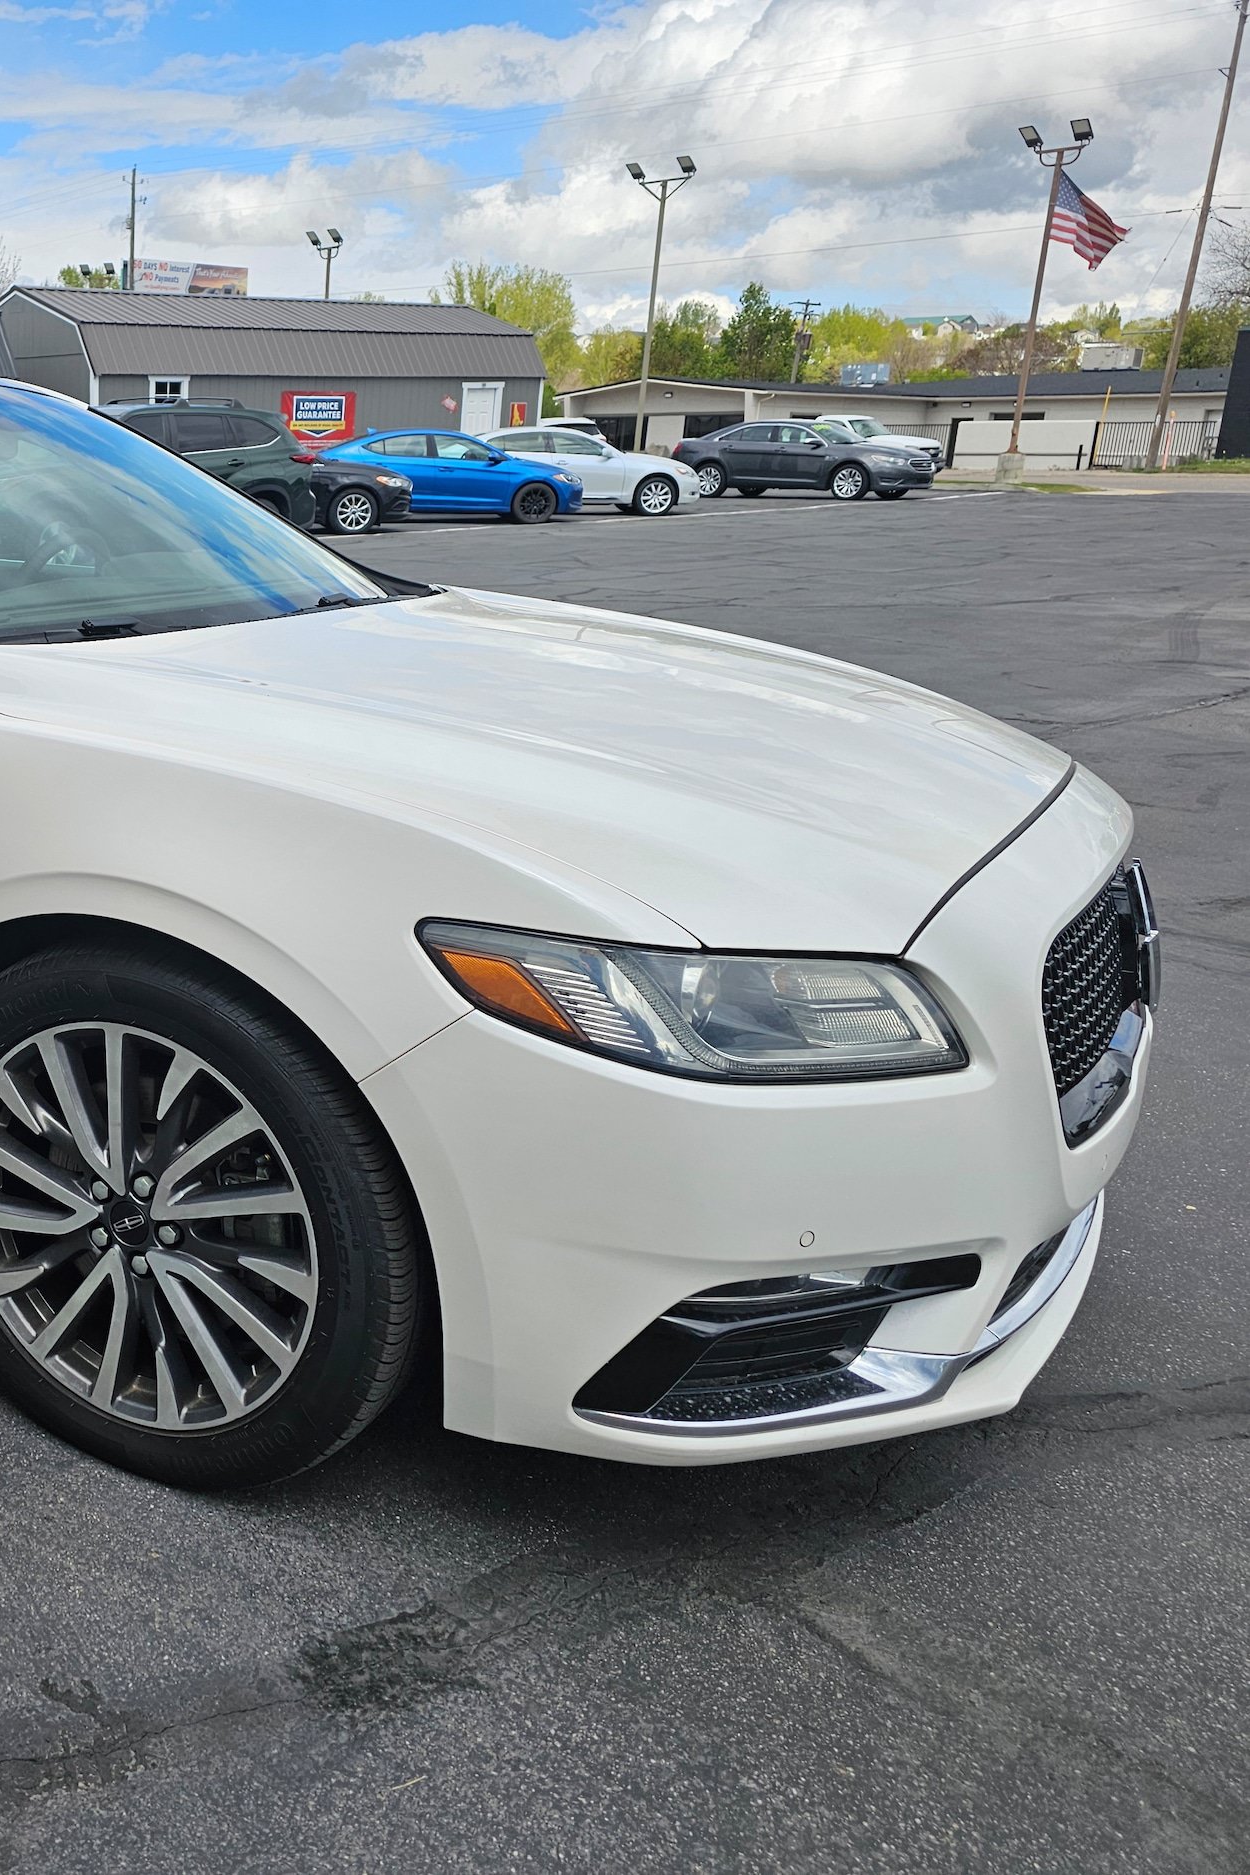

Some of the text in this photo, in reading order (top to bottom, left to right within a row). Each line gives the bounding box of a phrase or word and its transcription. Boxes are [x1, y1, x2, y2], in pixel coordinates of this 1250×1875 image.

[143, 261, 157, 271] DAYS
[158, 261, 168, 272] NO
[169, 264, 190, 273] Interest
[142, 271, 179, 284] NO Payments
[300, 402, 339, 410] LOW PRICE
[297, 411, 341, 419] GUARANTEE
